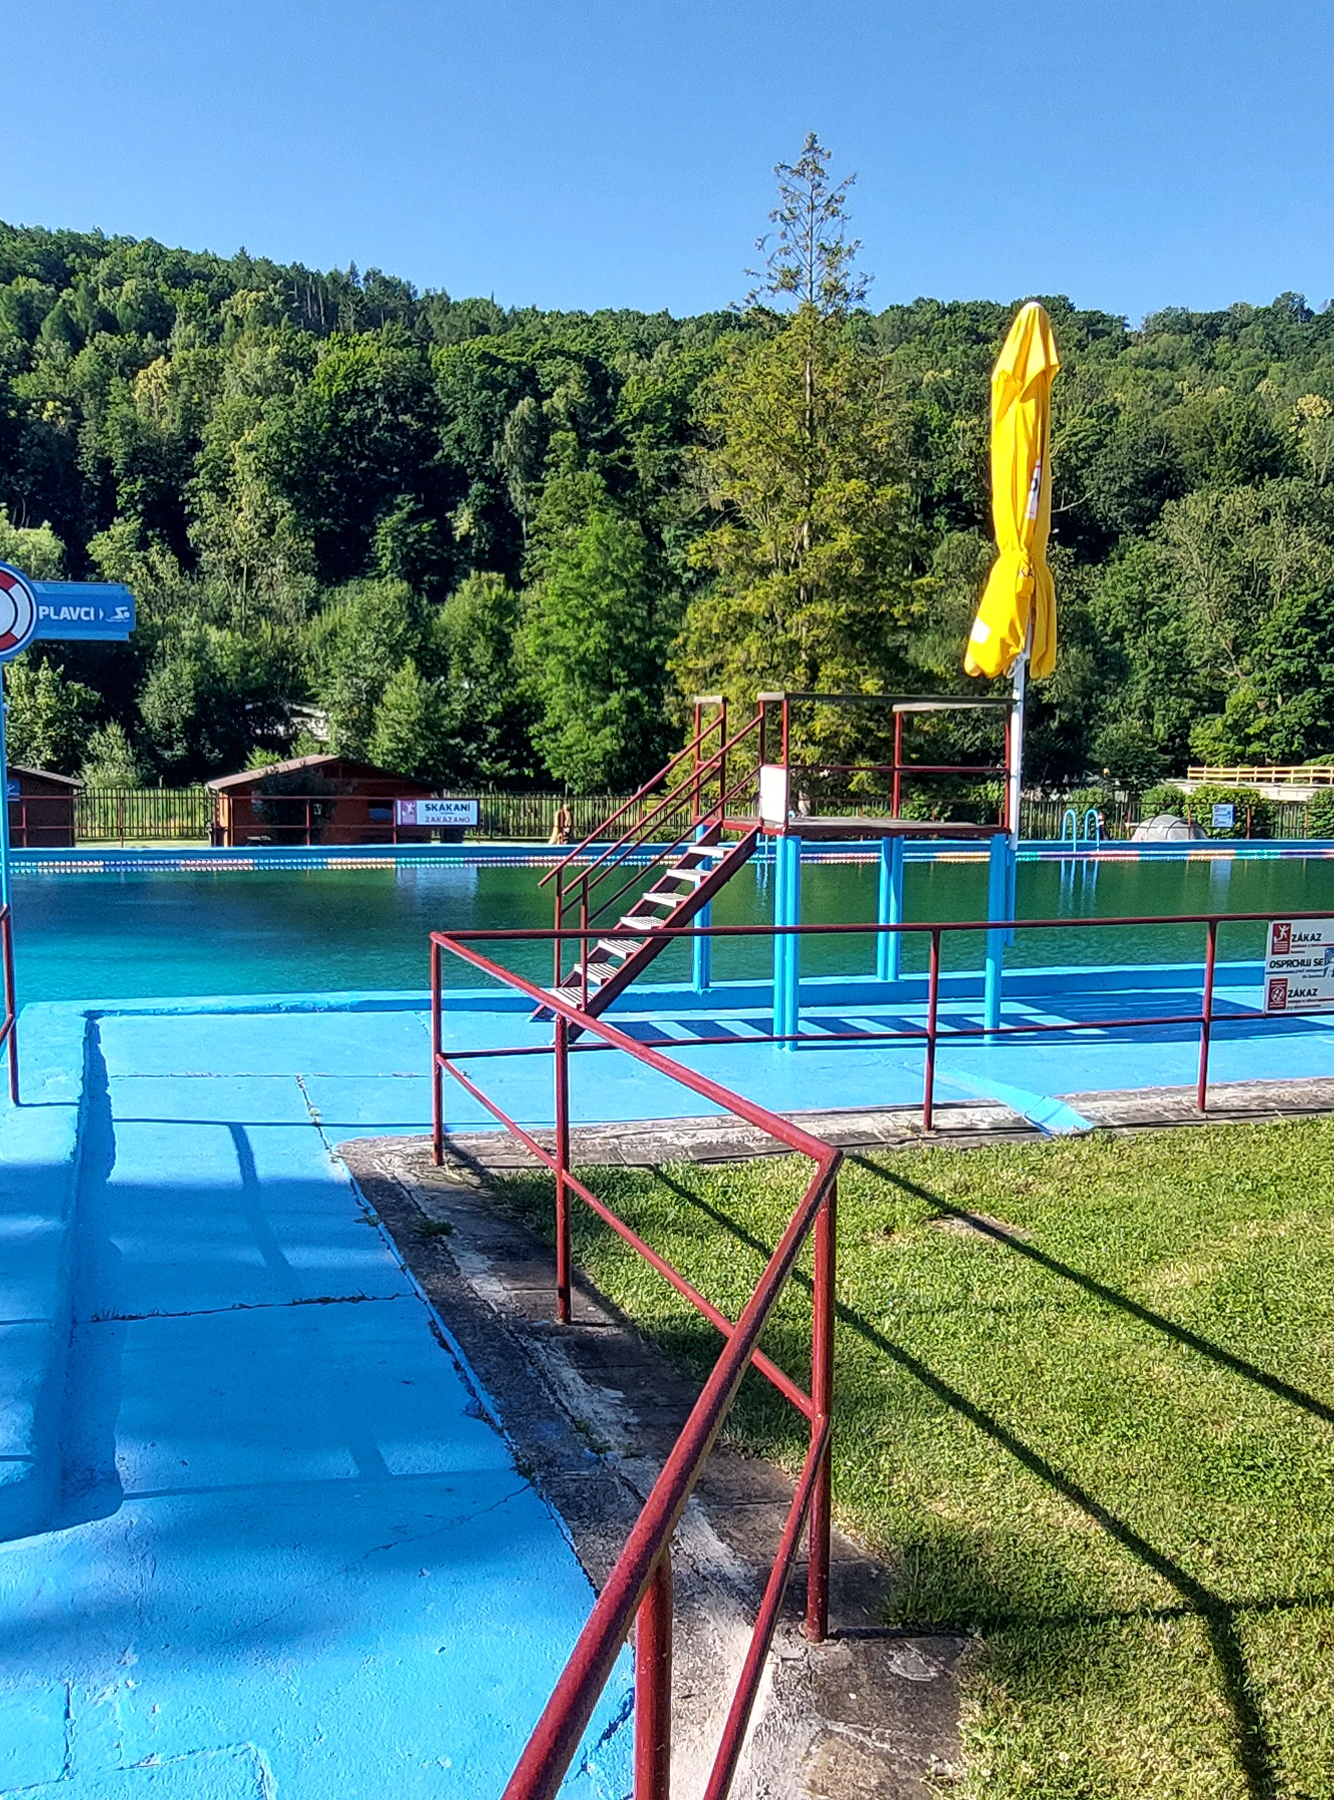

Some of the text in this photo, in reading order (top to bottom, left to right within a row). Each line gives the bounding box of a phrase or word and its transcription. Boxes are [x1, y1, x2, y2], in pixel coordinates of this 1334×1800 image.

[38, 605, 95, 621] PLAVCI
[1292, 932, 1322, 942] ZÁKAZ
[1313, 957, 1324, 967] SE
[1288, 988, 1318, 998] ZÁKAZ
